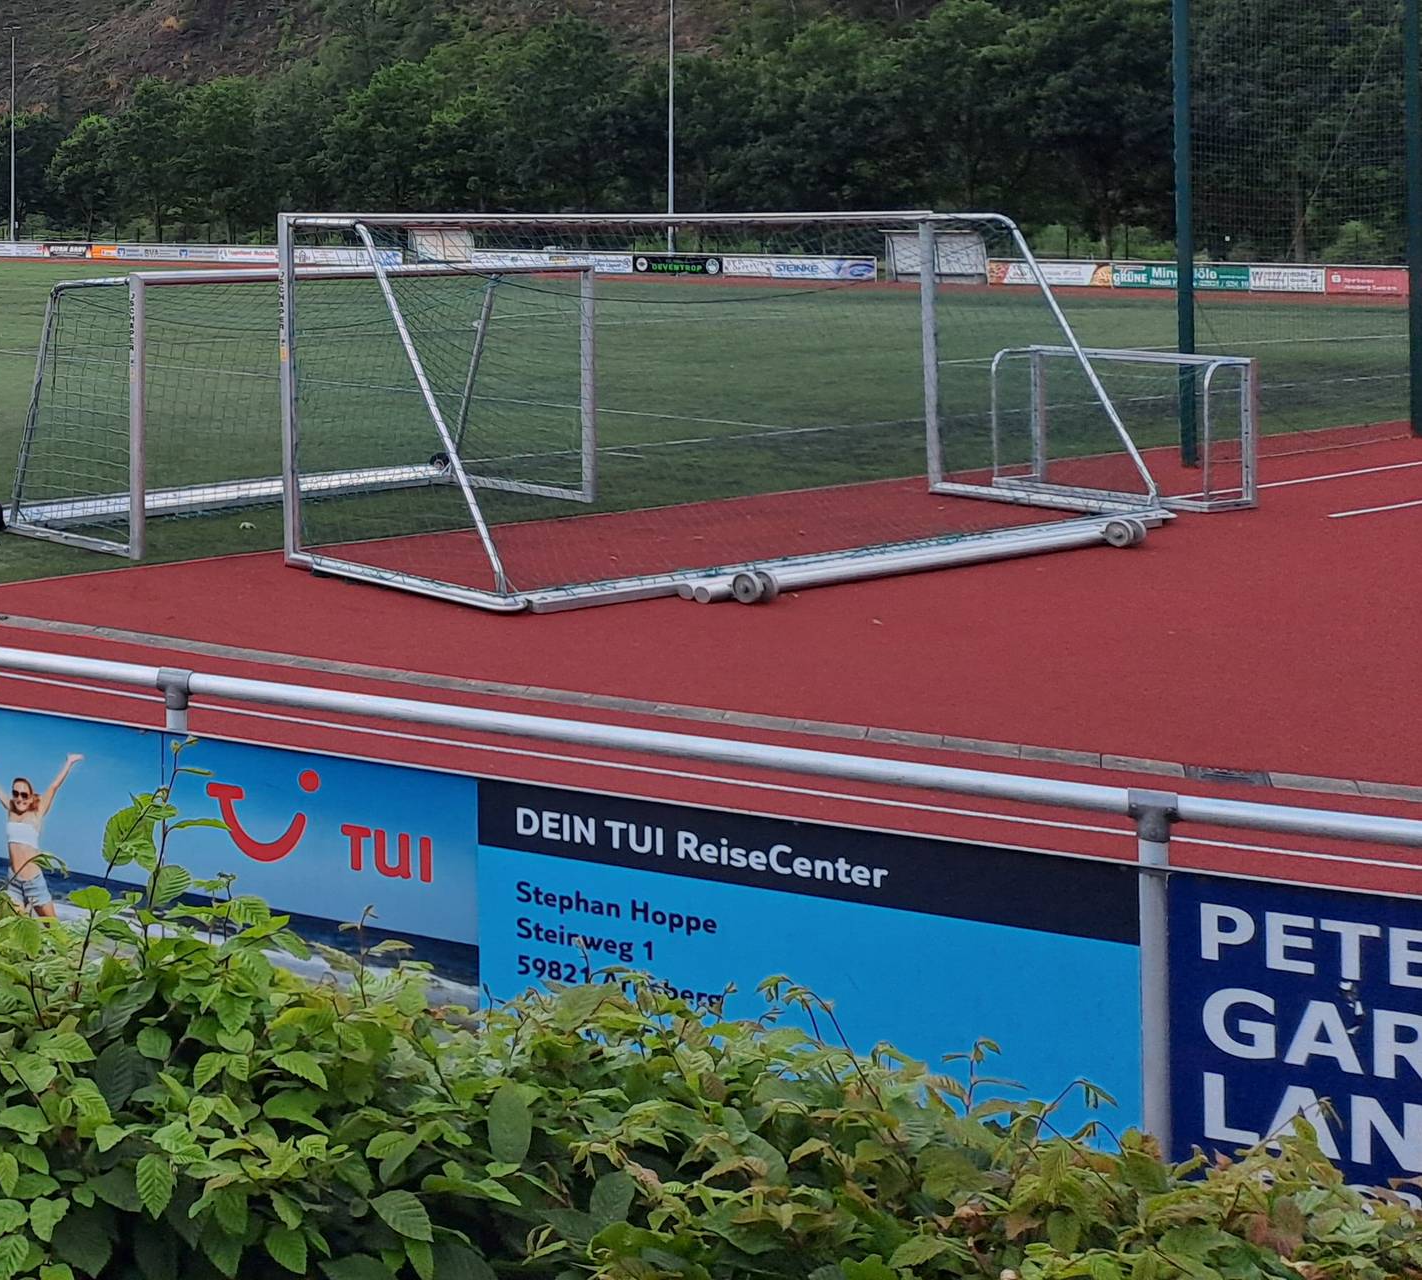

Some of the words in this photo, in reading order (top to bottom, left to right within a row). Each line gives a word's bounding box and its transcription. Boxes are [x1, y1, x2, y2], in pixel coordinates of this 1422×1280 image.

[652, 263, 702, 272] OEVENTROP
[775, 264, 818, 273] STEINKE
[341, 823, 433, 883] TUI
[516, 807, 596, 846] DEIN
[604, 819, 665, 856] TUI
[677, 830, 889, 889] ReiseCenter
[516, 881, 621, 918] Stephan
[631, 899, 718, 936] Hoppe
[643, 940, 654, 961] 1
[517, 954, 592, 985] 59821
